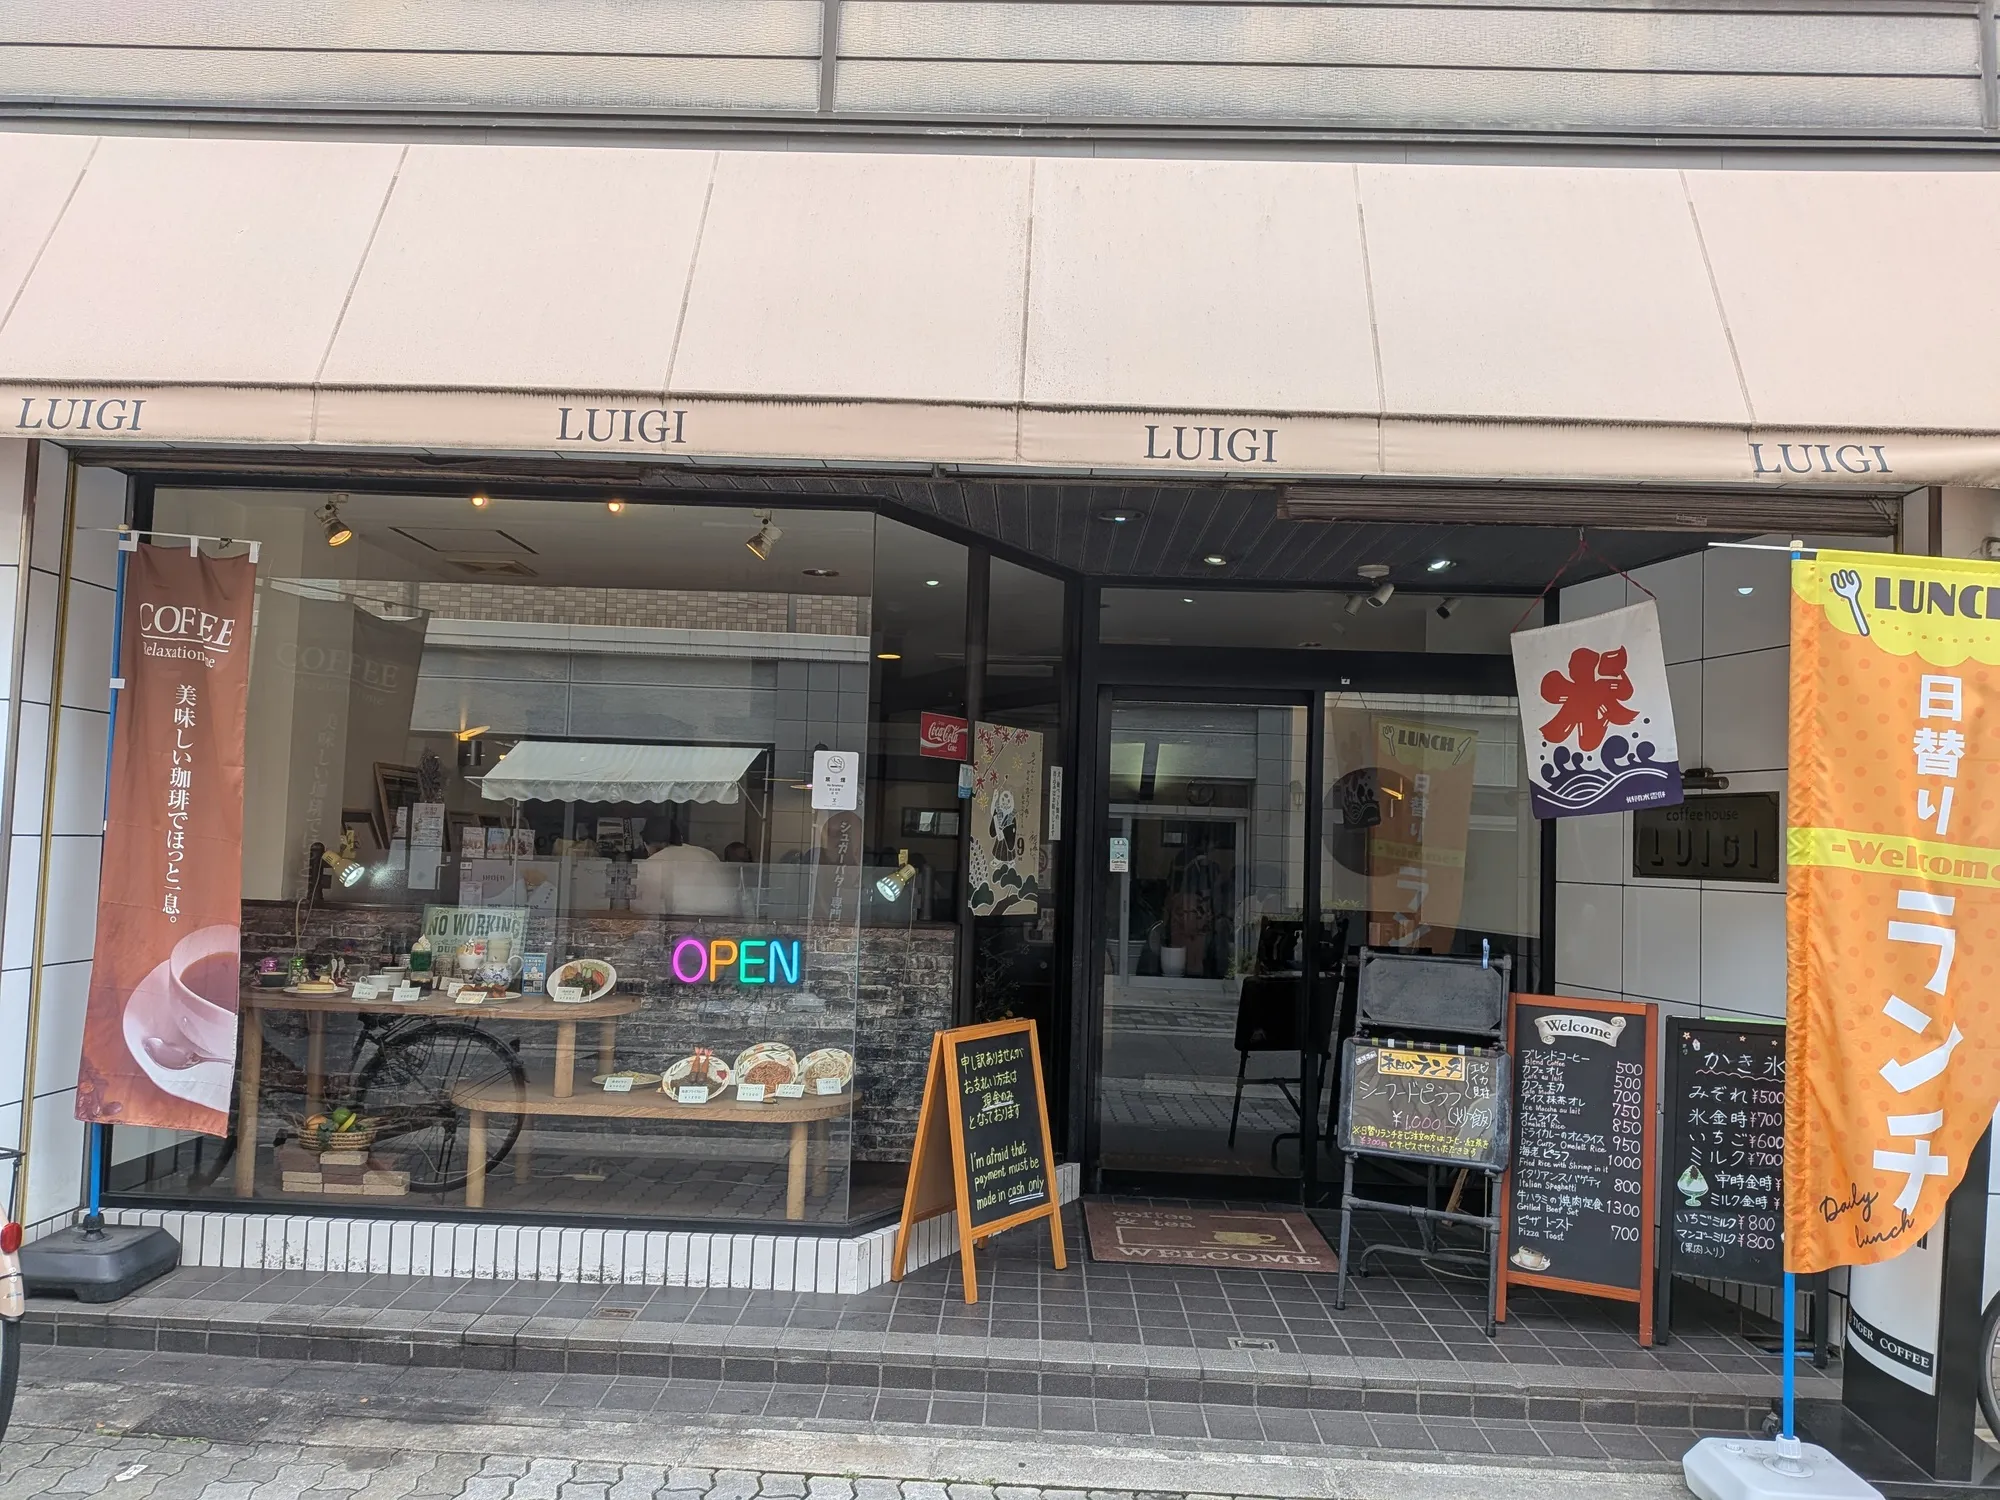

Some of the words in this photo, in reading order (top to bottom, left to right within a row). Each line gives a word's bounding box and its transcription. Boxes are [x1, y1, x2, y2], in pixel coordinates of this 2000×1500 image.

[16, 398, 148, 432] LUIGI
[556, 408, 687, 445] LUIGI
[1144, 425, 1277, 463] LUIGI
[1752, 442, 1892, 476] LUIGI
[1538, 645, 1641, 752] 氷
[1398, 729, 1455, 753] LUNCH
[1912, 673, 1966, 836] 日替り
[161, 683, 198, 925] 美味しい珈琲でほっと一息。
[427, 914, 449, 936] NO
[453, 911, 521, 939] WORKING
[672, 939, 799, 984] OPEN
[1544, 1019, 1612, 1040] Welcome
[960, 1047, 1024, 1074] 申し訳ありませんが
[1521, 1049, 1590, 1062] ブレンドコーヒー
[1615, 1061, 1643, 1076] 500
[1704, 1052, 1786, 1076] かき氷
[1872, 890, 1964, 1216] ランチ
[963, 1070, 1017, 1094] お支払い方法は
[1613, 1075, 1641, 1090] 500
[982, 1090, 1014, 1108] 現金のみ
[1613, 1089, 1641, 1104] 700
[1688, 1085, 1748, 1104] みぞれ
[1751, 1088, 1785, 1104] ¥500
[969, 1103, 1021, 1130] となっております
[1612, 1102, 1641, 1119] 750
[1688, 1108, 1748, 1128] 氷金時
[1750, 1111, 1783, 1128] ¥700
[1520, 1112, 1560, 1124] オムライス
[1612, 1118, 1642, 1135] 850
[1520, 1127, 1605, 1146] ドライカレーのオムライス
[1612, 1135, 1641, 1154] 950
[1536, 1139, 1556, 1149] Curry
[1689, 1130, 1748, 1147] いちご
[1749, 1133, 1784, 1149] ¥600
[986, 1147, 1010, 1166] afraid
[1011, 1140, 1028, 1158] that
[1608, 1154, 1641, 1170] 1000
[1690, 1146, 1745, 1167] ミルク
[1747, 1151, 1783, 1166] ¥700
[974, 1168, 1007, 1192] payment
[1008, 1158, 1029, 1175] must
[1029, 1156, 1040, 1169] be
[1518, 1158, 1535, 1167] Fried
[1538, 1159, 1552, 1168] Rice
[1553, 1161, 1567, 1169] with
[1568, 1162, 1592, 1173] Shrimp
[976, 1193, 997, 1211] made
[998, 1189, 1006, 1203] in
[1008, 1182, 1025, 1197] cash
[1028, 1174, 1045, 1195] only
[1519, 1178, 1542, 1189] Italian
[1613, 1178, 1641, 1195] 800
[1546, 1204, 1563, 1214] Beef
[1566, 1207, 1579, 1216] Set
[1606, 1200, 1640, 1218] 1300
[1710, 1192, 1768, 1210] ミルク金時
[1819, 1182, 1879, 1223] Daily
[1112, 1210, 1194, 1221] coffee
[1676, 1213, 1737, 1229] いちごミルク
[1737, 1214, 1776, 1232] ¥800
[1518, 1227, 1540, 1238] Pizza
[1543, 1230, 1565, 1240] Toast
[1610, 1225, 1639, 1241] 700
[1677, 1229, 1736, 1244] マンゴーミルク
[1737, 1233, 1775, 1250] ¥800
[1855, 1207, 1914, 1250] lunch
[1113, 1246, 1322, 1266] WELCOME
[1852, 1315, 1874, 1341] TIGER
[1879, 1337, 1930, 1368] COFFEE
